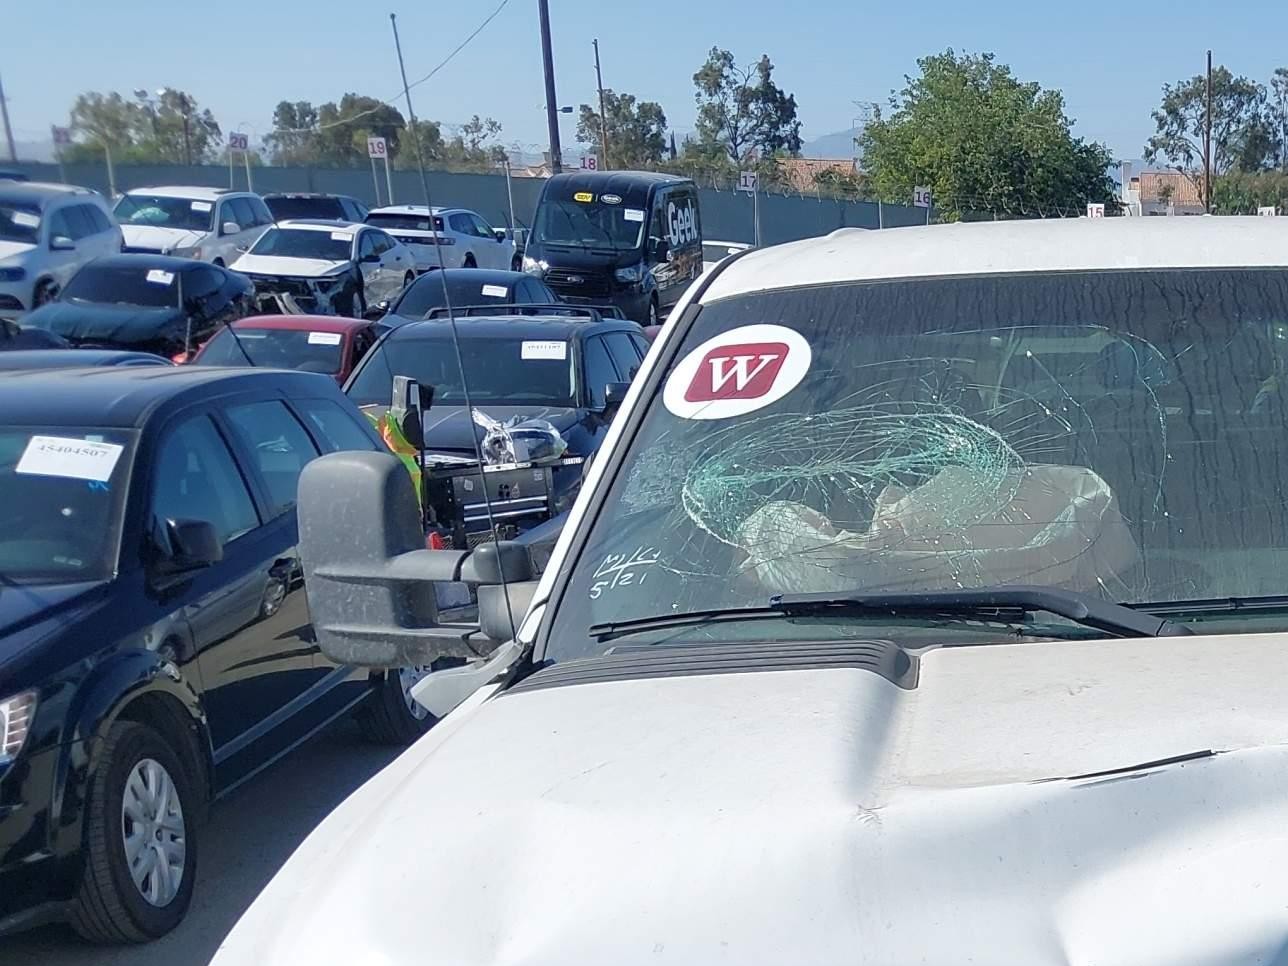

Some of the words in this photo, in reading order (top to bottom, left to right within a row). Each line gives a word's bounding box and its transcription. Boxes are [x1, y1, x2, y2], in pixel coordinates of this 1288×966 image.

[230, 136, 248, 150] 20
[370, 142, 384, 155] 19
[580, 156, 597, 170] 18
[742, 175, 757, 188] 17
[915, 191, 930, 204] 16
[1088, 207, 1103, 218] 15
[668, 198, 698, 246] Geek
[708, 353, 780, 394] W
